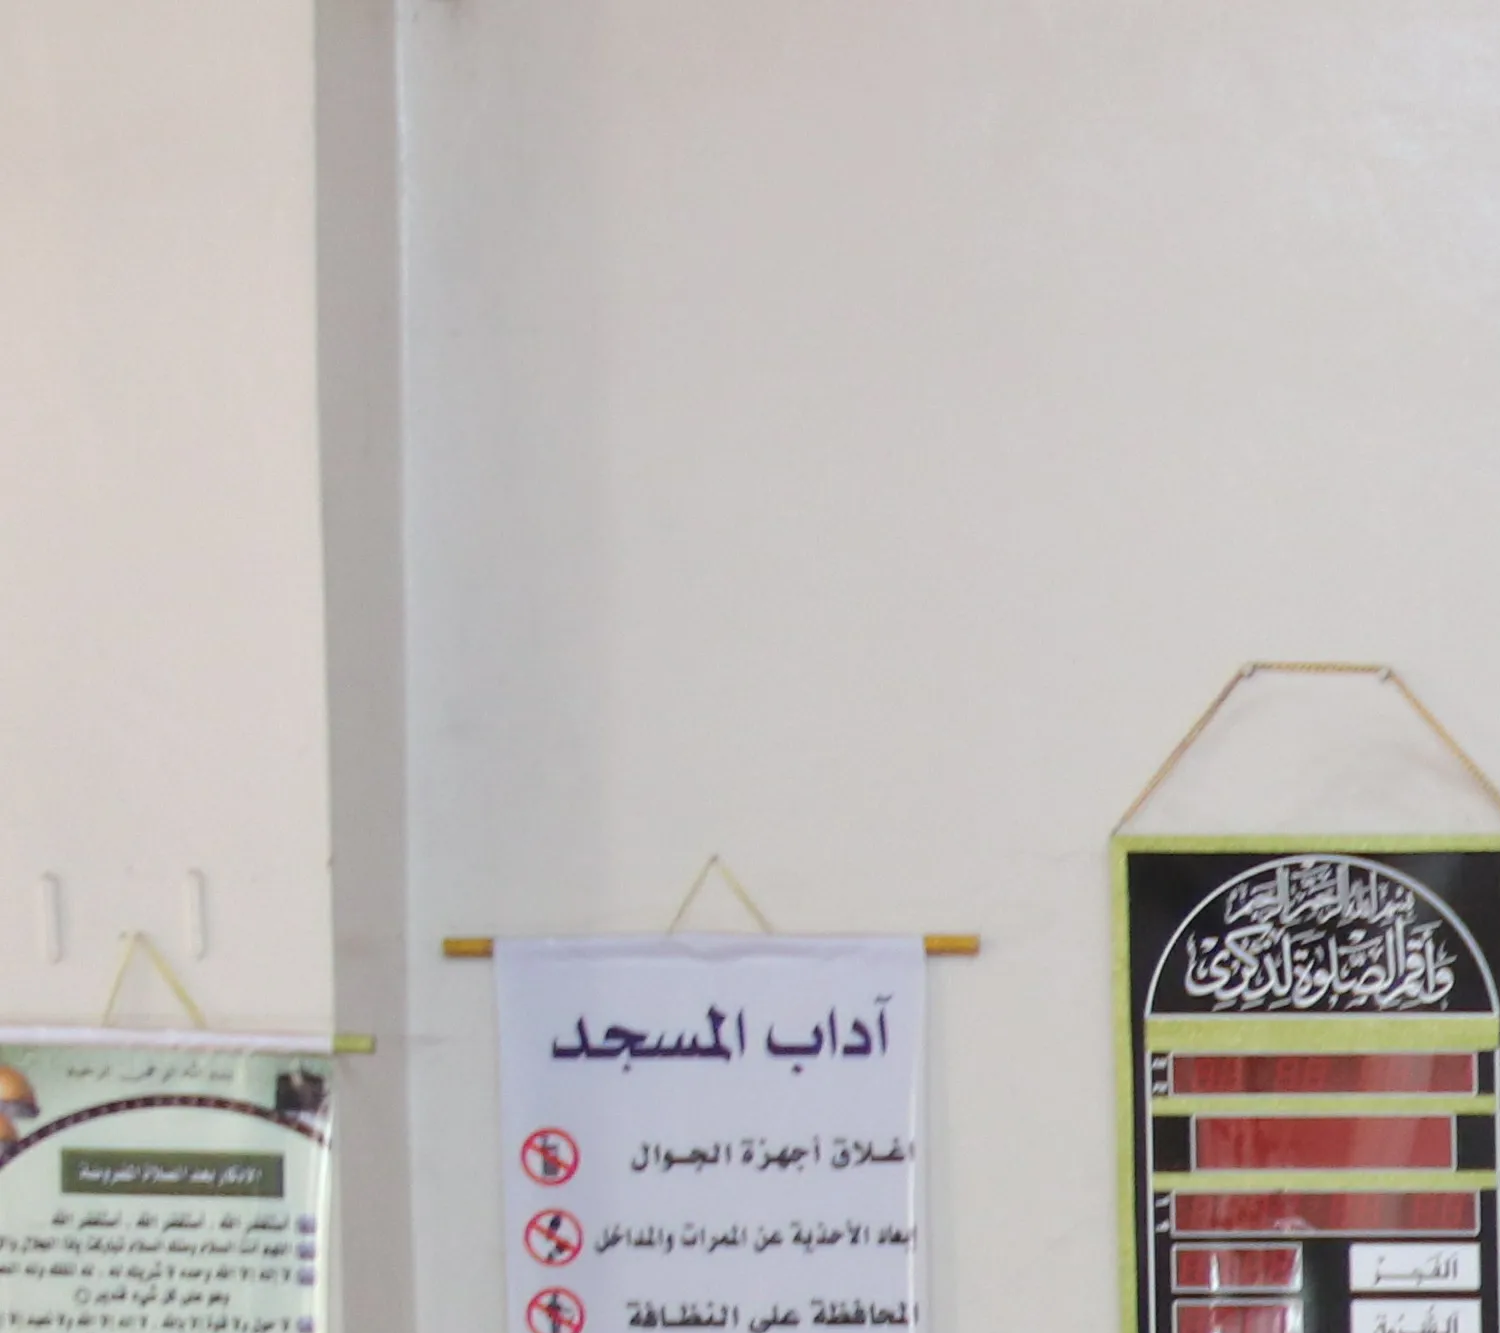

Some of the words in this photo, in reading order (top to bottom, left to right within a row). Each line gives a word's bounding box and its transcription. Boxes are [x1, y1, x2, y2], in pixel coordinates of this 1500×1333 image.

[551, 1004, 746, 1073] المسجد
[766, 994, 893, 1074] آداب
[630, 1140, 732, 1173] الجوال
[741, 1135, 820, 1172] أجهزة
[593, 1222, 675, 1254] والمداخل
[680, 1221, 747, 1254] الممرات
[752, 1221, 784, 1253] عن
[627, 1297, 740, 1330] النظافة
[748, 1303, 802, 1333] على
[811, 1296, 919, 1328] المحافظة
